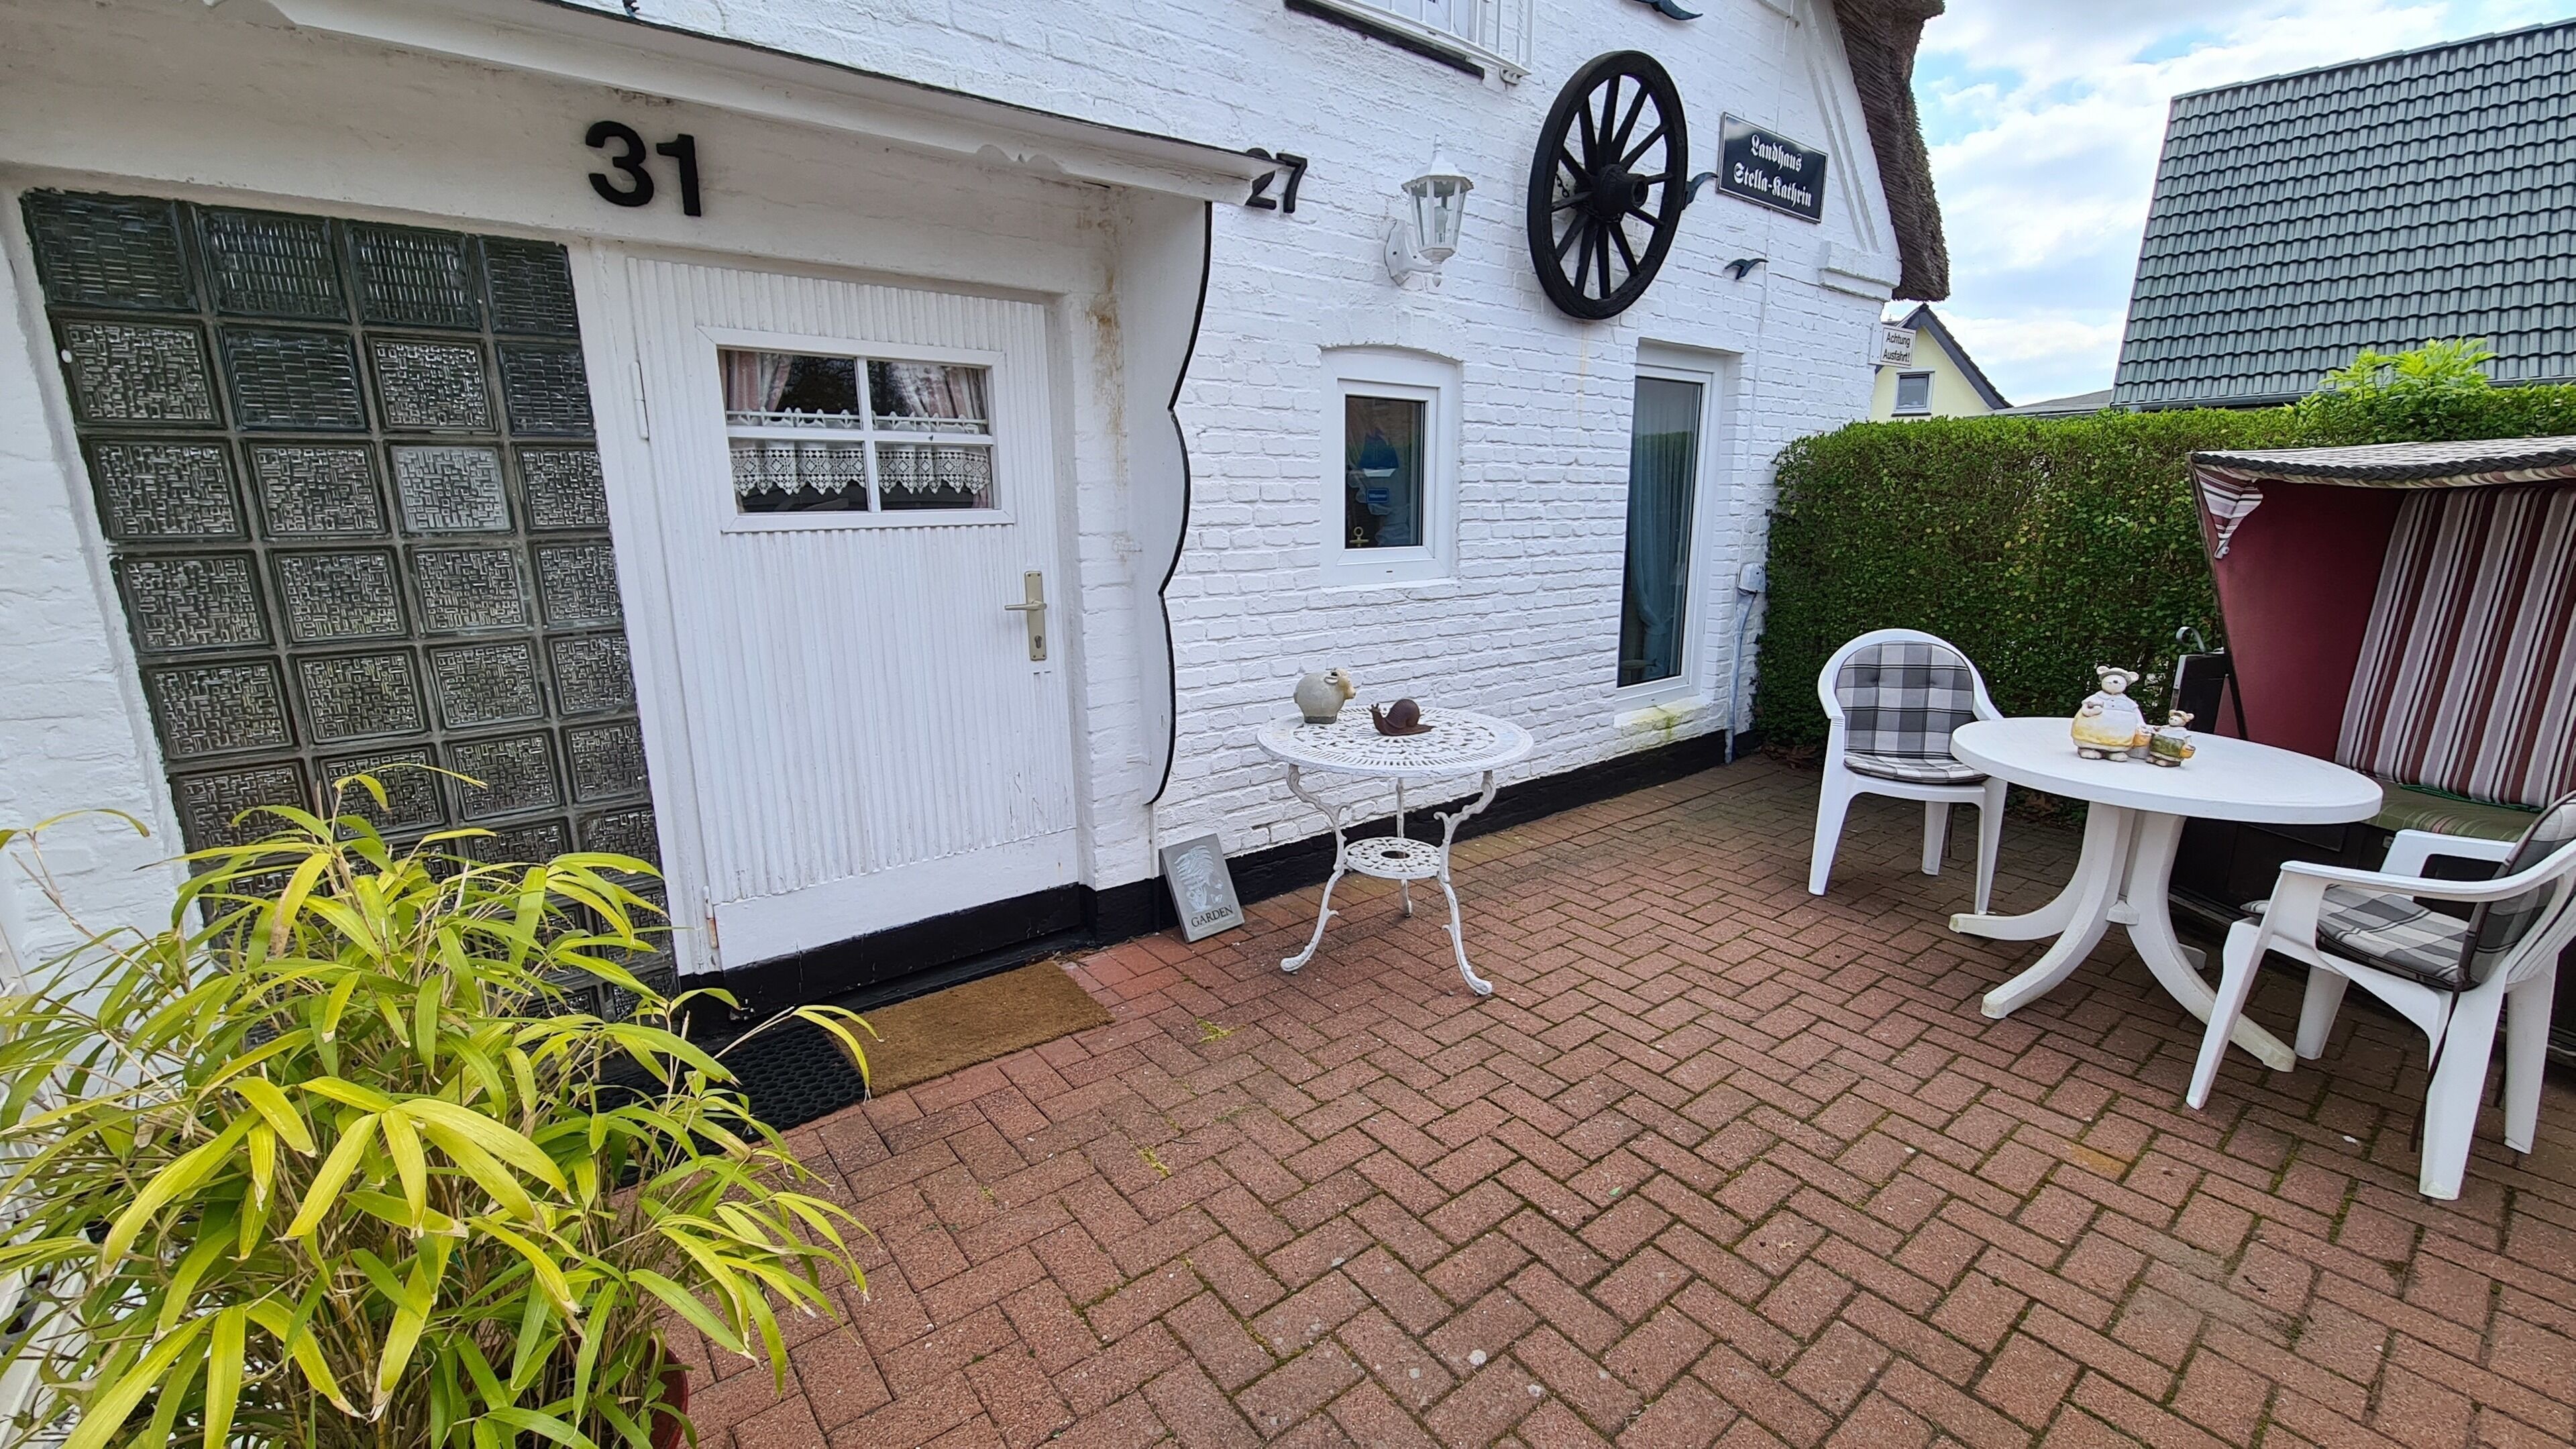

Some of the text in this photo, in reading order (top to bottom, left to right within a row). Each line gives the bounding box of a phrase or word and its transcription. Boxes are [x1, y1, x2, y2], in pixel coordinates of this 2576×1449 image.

[586, 120, 701, 217] 31
[1751, 135, 1802, 172] Landhaus
[1244, 147, 1307, 213] 27
[1733, 162, 1812, 207] Stella-Kathrin
[1883, 349, 1910, 362] Ausfahrt!
[1886, 332, 1910, 348] Achtung
[1191, 904, 1234, 928] GARDEN
